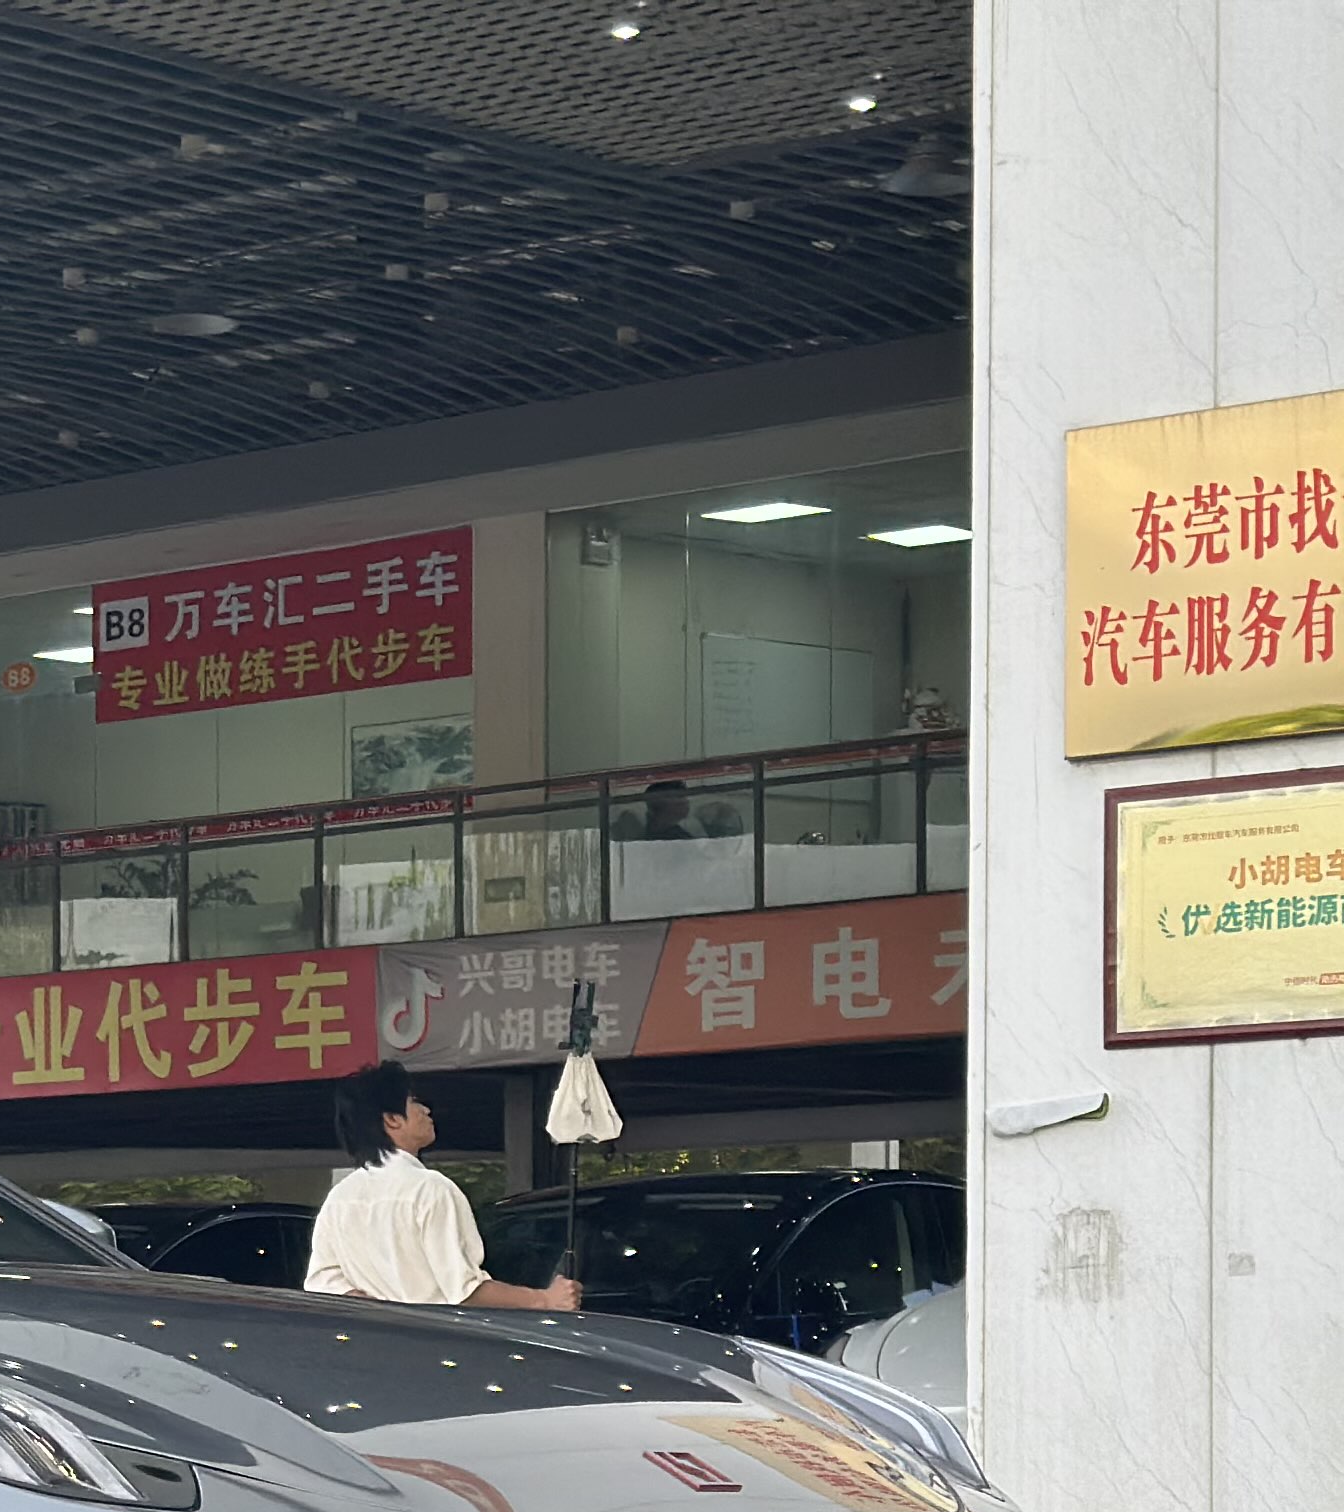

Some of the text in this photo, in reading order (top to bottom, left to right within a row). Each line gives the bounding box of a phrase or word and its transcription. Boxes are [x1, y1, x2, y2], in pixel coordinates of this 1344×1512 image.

[1131, 468, 1339, 574] 东莞市找
[105, 551, 459, 642] B8 万车汇二手车
[1081, 579, 1342, 687] 汽车服务有
[111, 622, 456, 711] 专业做练手代步车
[1181, 894, 1344, 937] 优选新能源
[458, 942, 621, 997] 兴哥电车
